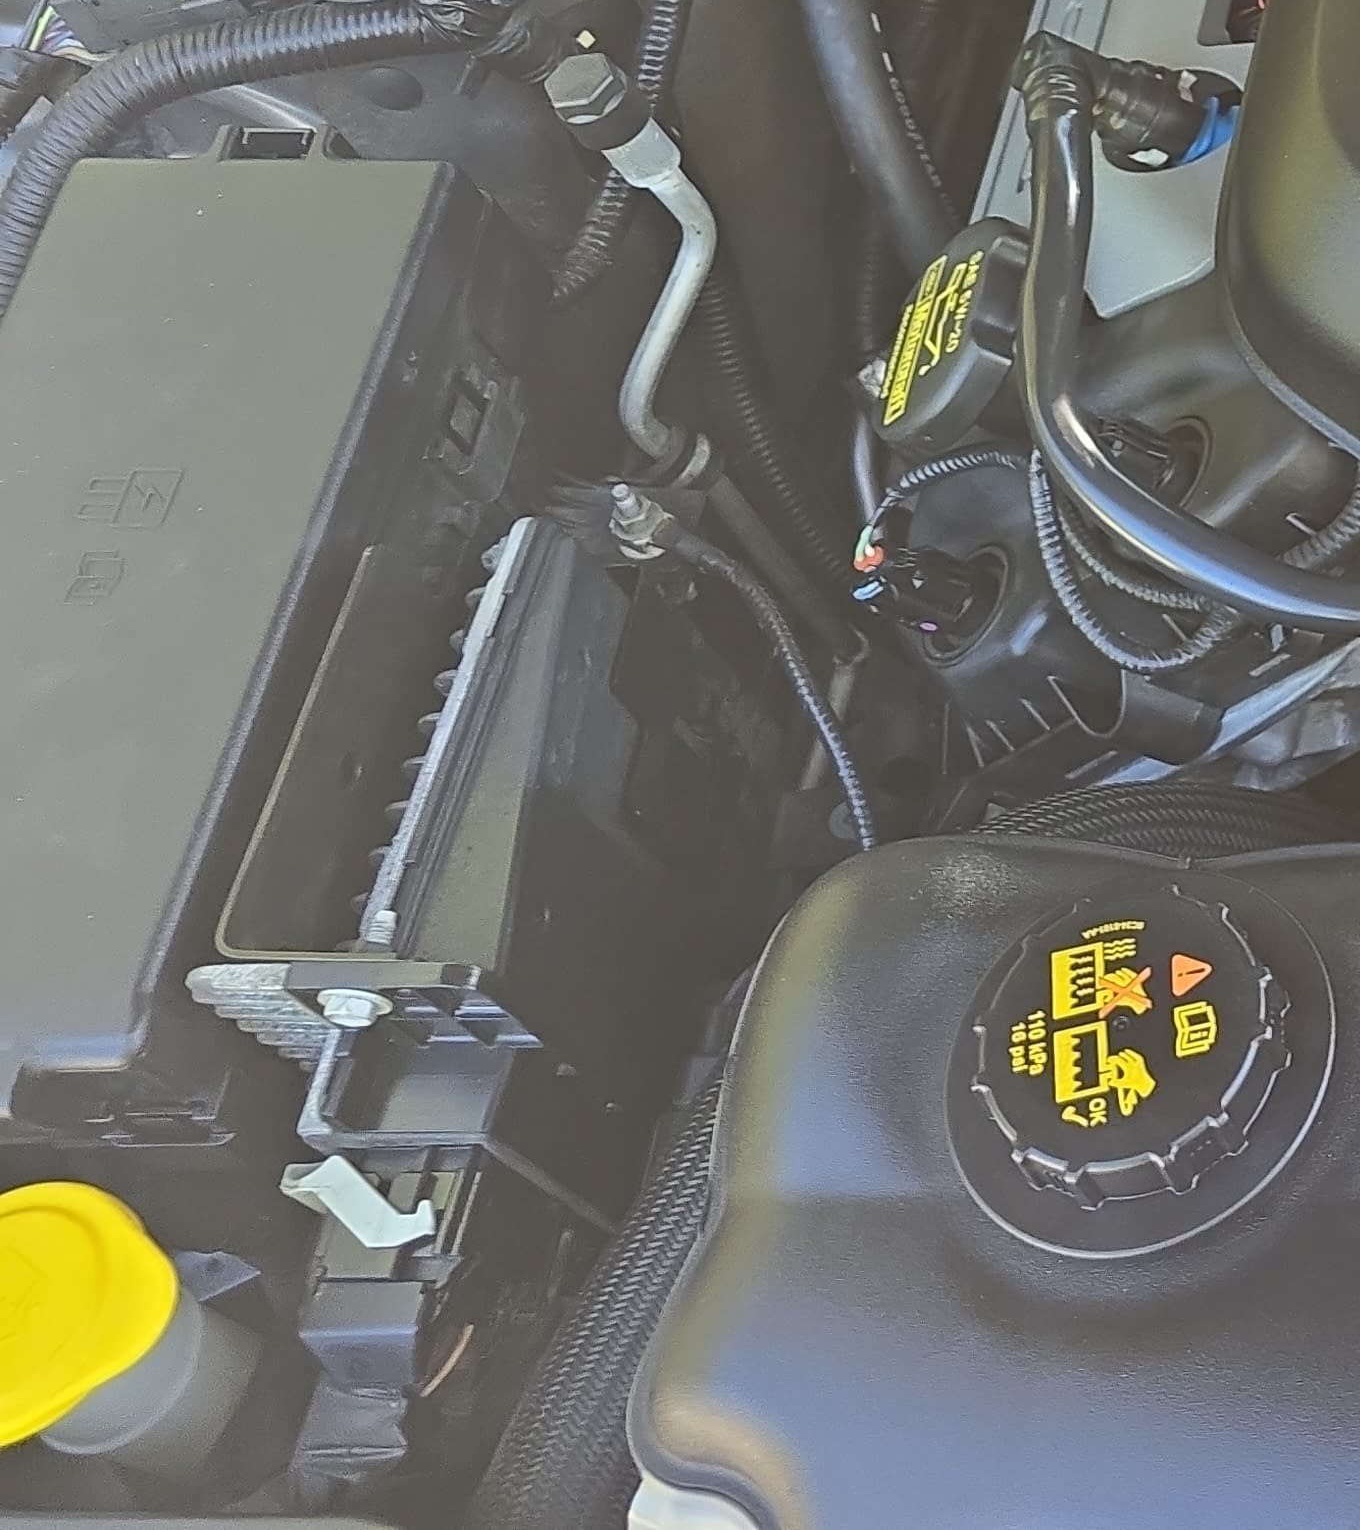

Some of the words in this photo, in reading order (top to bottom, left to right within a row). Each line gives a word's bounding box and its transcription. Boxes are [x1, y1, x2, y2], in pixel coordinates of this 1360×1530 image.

[888, 76, 943, 188] GOODYEAR
[963, 250, 984, 289] SAE
[1011, 1022, 1027, 1042] 16
[1027, 1010, 1047, 1041] 110
[1009, 1045, 1029, 1073] psi
[1028, 1042, 1048, 1076] kPa
[1088, 1097, 1108, 1127] OK
